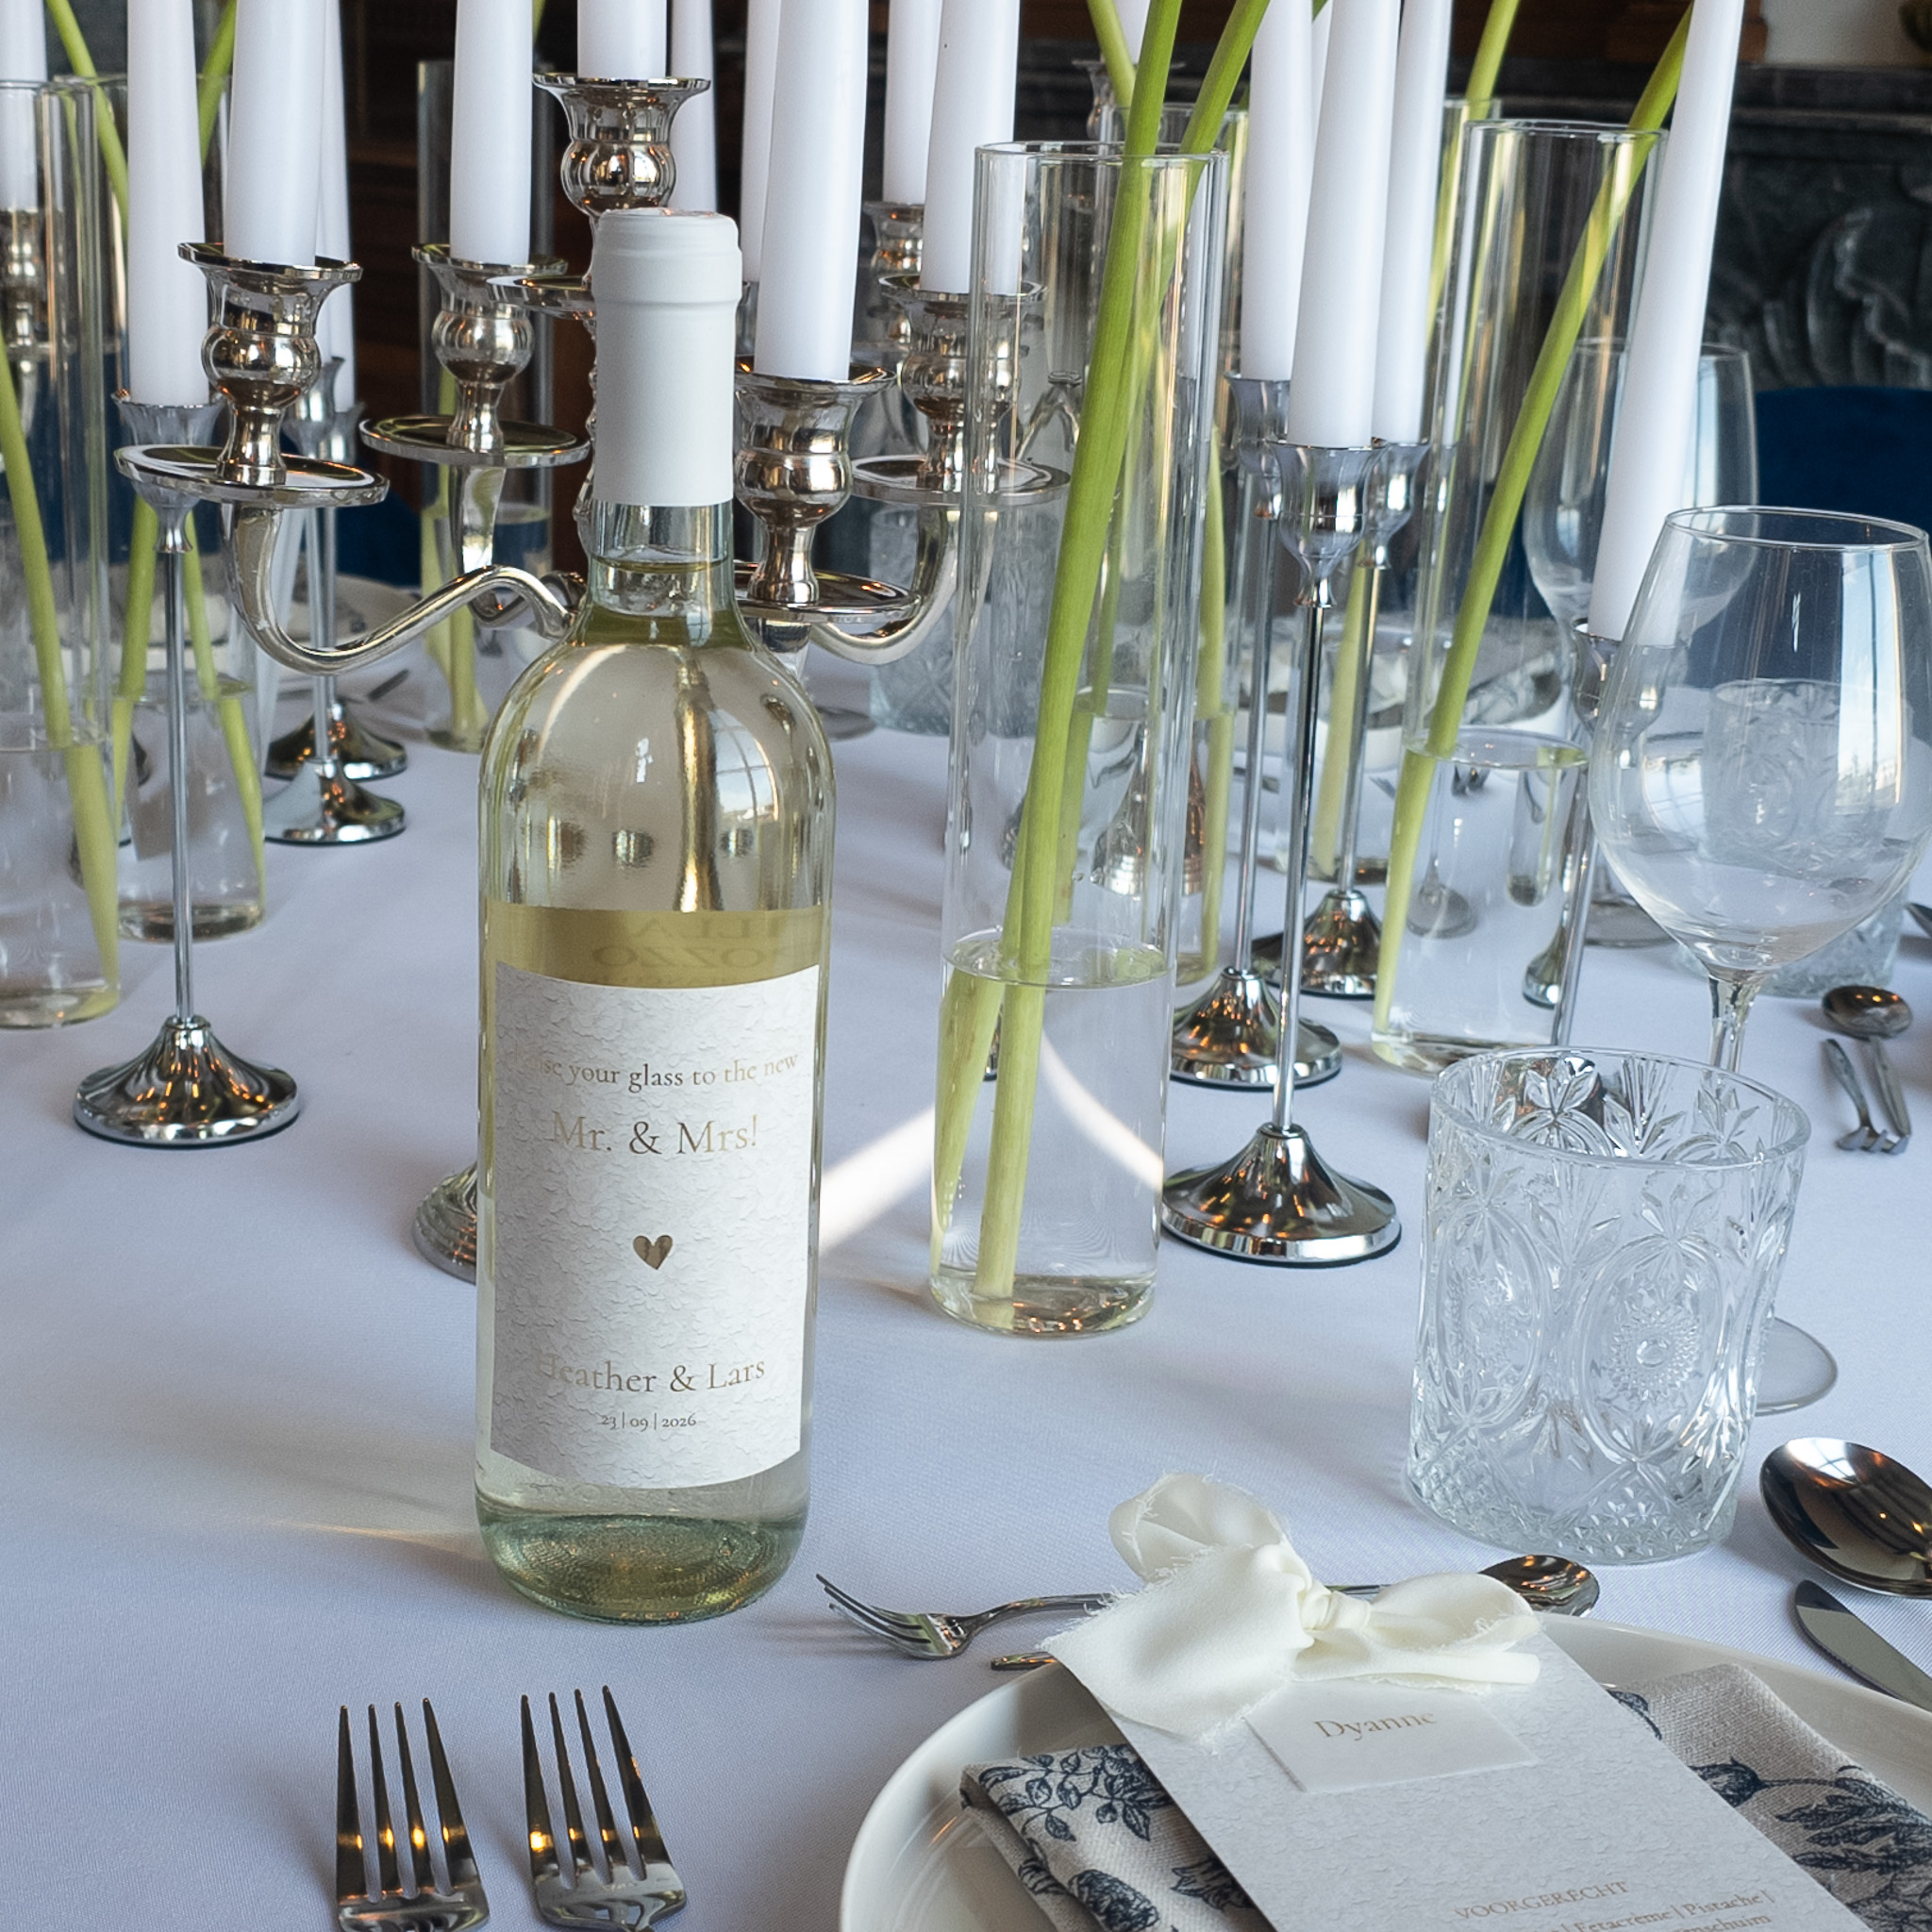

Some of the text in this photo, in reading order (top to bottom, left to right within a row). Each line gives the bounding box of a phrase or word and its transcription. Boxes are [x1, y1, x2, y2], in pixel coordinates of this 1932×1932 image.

[563, 1064, 620, 1087] your
[628, 1063, 683, 1094] glass
[692, 1069, 716, 1086] to
[724, 1059, 757, 1083] the
[763, 1054, 800, 1076] new
[549, 1110, 758, 1155] Mr. & Mrs!
[534, 1349, 765, 1393] Heather & Lars
[1313, 1711, 1439, 1741] Dyanne
[1453, 1880, 1629, 1919] VOORGERECHT
[1683, 1893, 1762, 1916] Pistache
